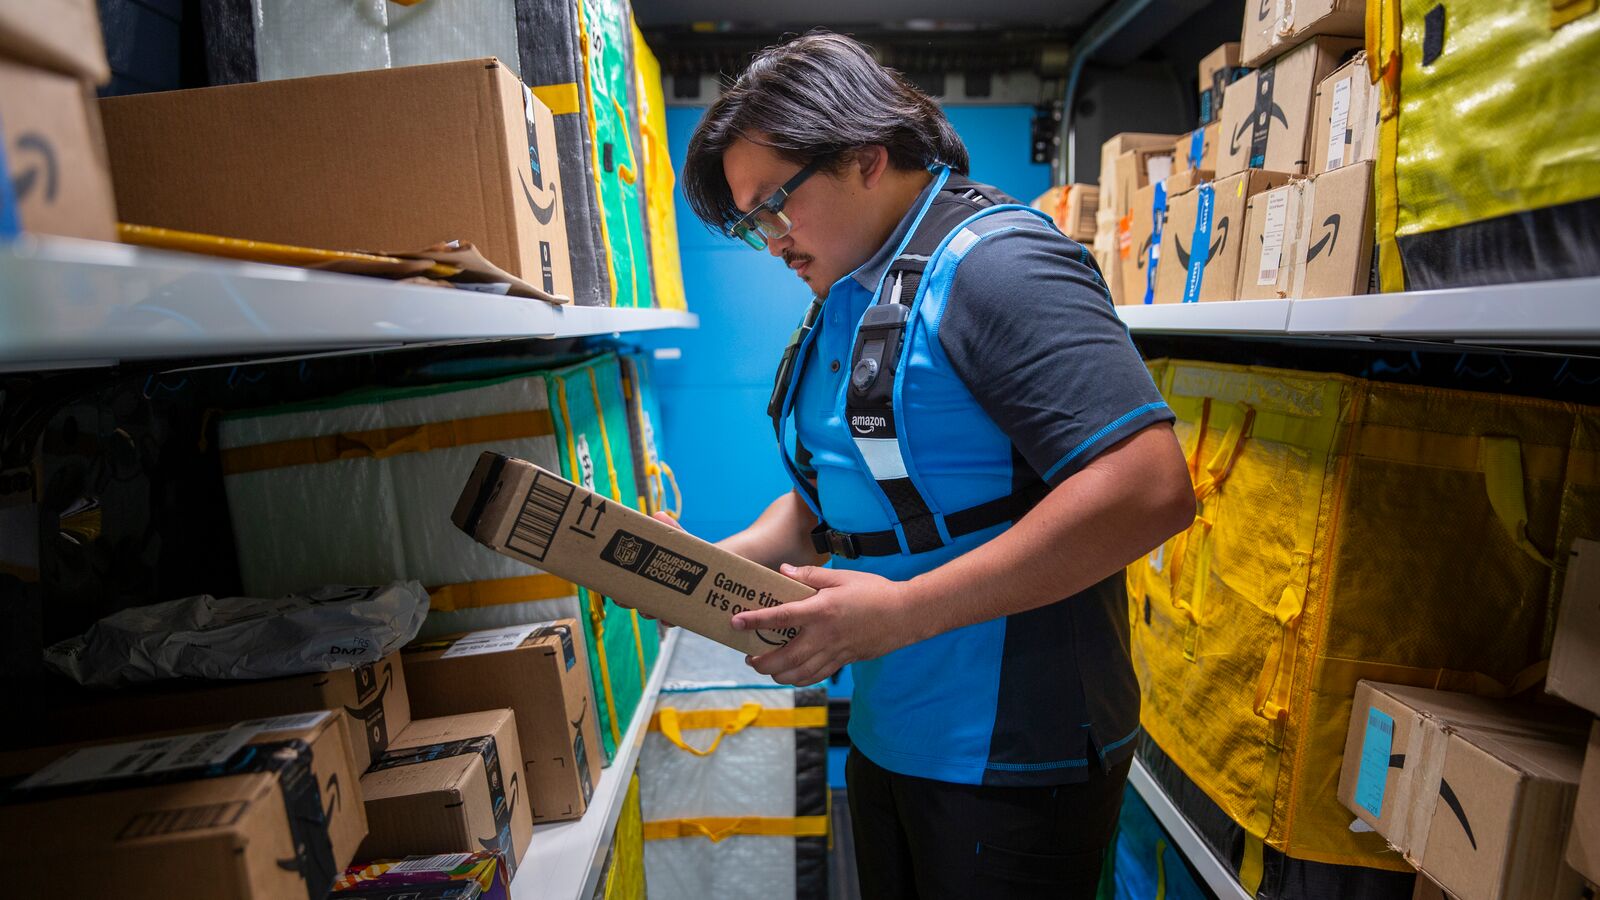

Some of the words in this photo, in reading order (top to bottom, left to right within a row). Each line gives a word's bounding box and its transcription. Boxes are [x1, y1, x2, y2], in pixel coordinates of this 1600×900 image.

[851, 415, 887, 428] amazon
[616, 546, 635, 563] NFL
[655, 550, 704, 576] THURSDAY
[644, 566, 690, 591] FOOTBALL
[650, 558, 681, 577] NIGHT
[705, 589, 730, 611] It's
[713, 572, 756, 601] Game
[758, 591, 785, 608] tim
